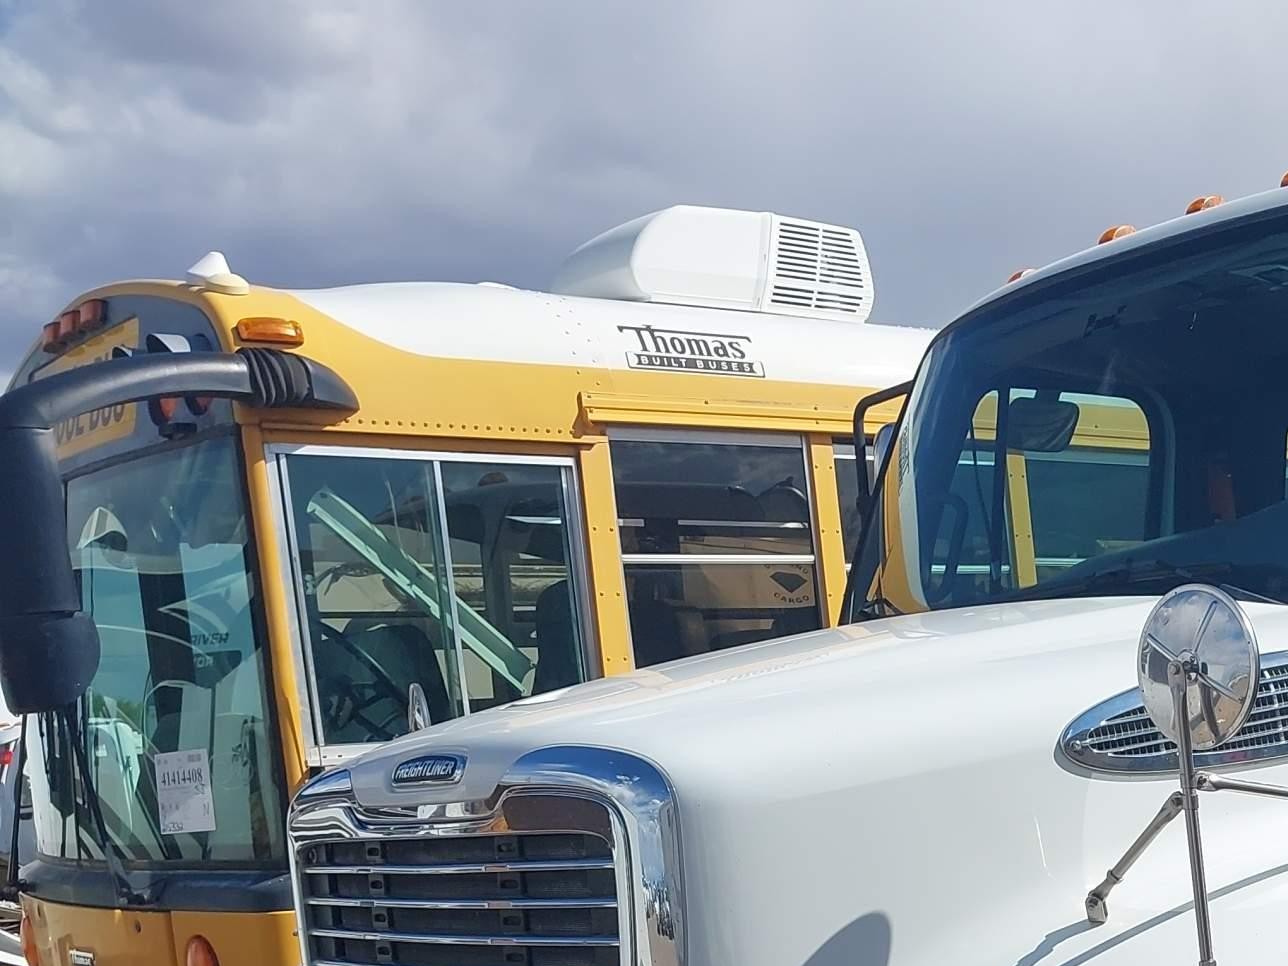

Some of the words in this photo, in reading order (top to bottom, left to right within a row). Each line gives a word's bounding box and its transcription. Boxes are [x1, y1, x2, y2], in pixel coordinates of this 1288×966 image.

[617, 325, 752, 359] Thomas
[639, 355, 686, 368] BUILT
[696, 360, 751, 372] BUSES
[395, 759, 455, 779] FREIGHTLINER
